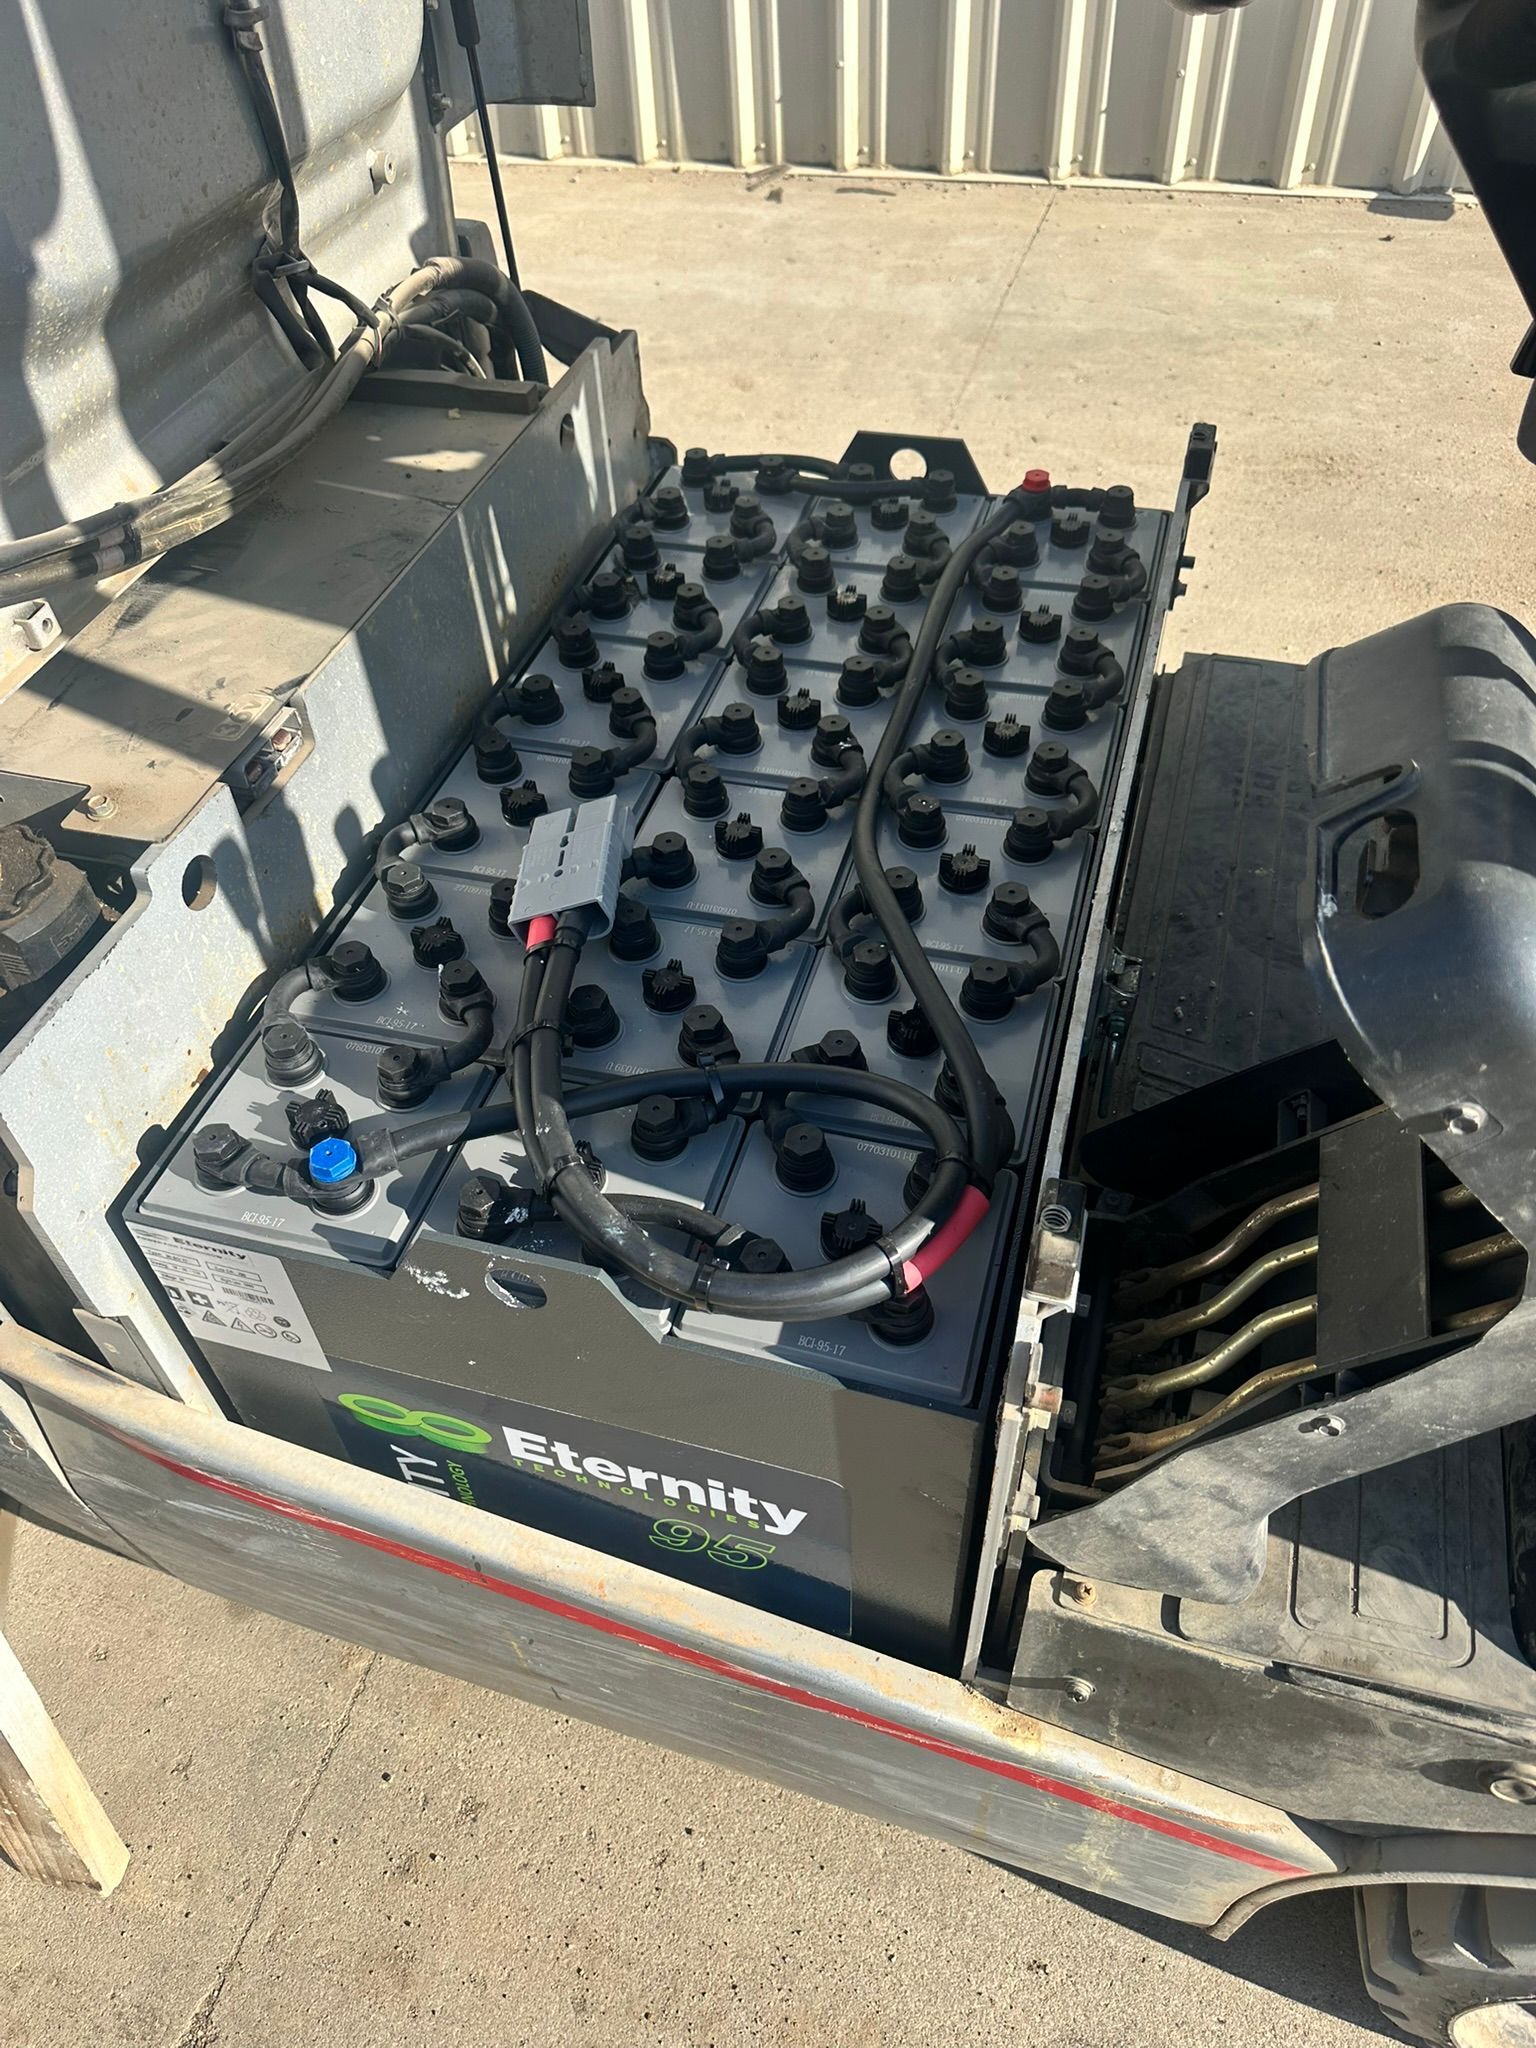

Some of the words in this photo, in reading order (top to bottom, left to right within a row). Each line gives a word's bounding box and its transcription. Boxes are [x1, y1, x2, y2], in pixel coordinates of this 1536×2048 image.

[376, 1016, 418, 1030] BCI-95-17
[856, 1142, 916, 1161] 077031011-U
[241, 1210, 286, 1228] BCI-95-17
[172, 1236, 247, 1260] Eternity
[798, 1335, 847, 1356] BCI-95-17
[502, 1426, 808, 1536] Eternity
[512, 1458, 761, 1530] TECHNOLOGIES
[649, 1518, 776, 1570] 95
